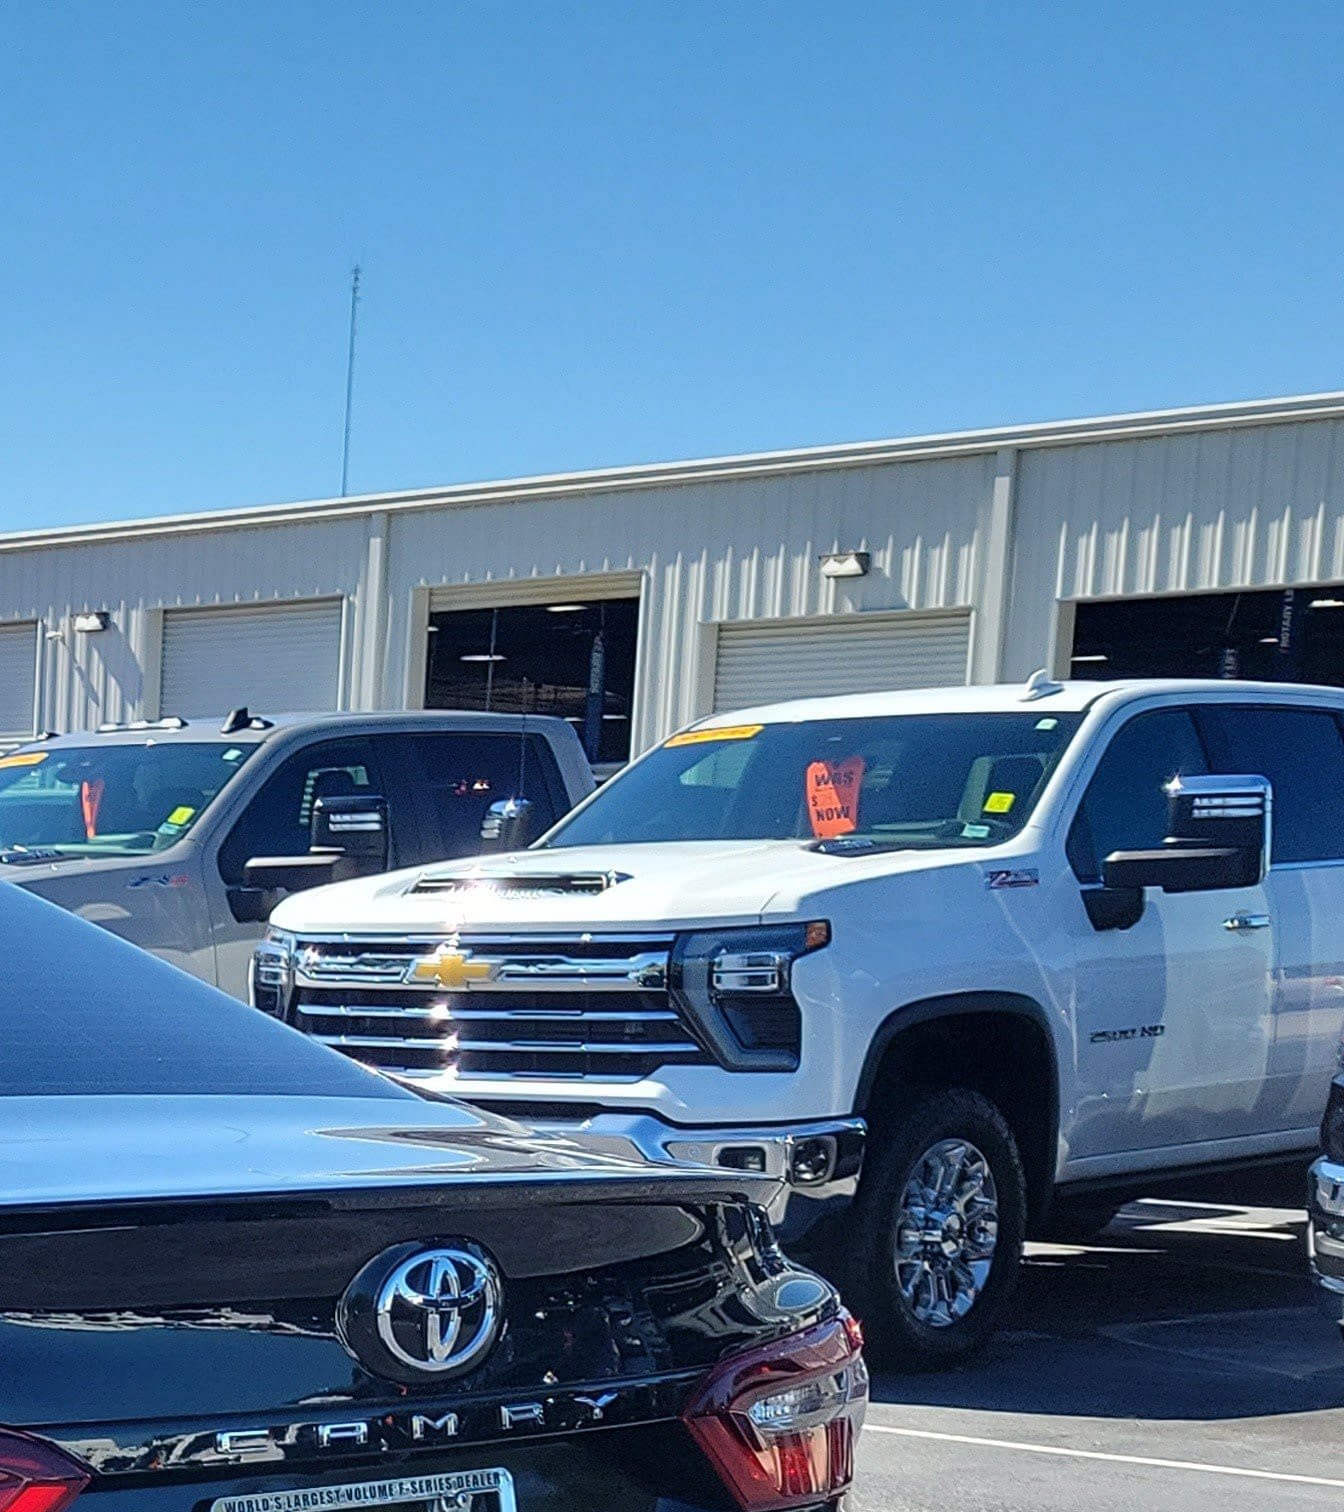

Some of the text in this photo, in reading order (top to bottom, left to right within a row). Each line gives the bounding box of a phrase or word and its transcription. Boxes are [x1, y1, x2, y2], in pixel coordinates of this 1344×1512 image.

[816, 806, 850, 821] NOW
[216, 1393, 618, 1453] CAMRY
[286, 1489, 341, 1509] LARGEST
[345, 1483, 395, 1501] VOLUME
[399, 1478, 453, 1495] F-SERIES
[457, 1471, 502, 1490] DEALER
